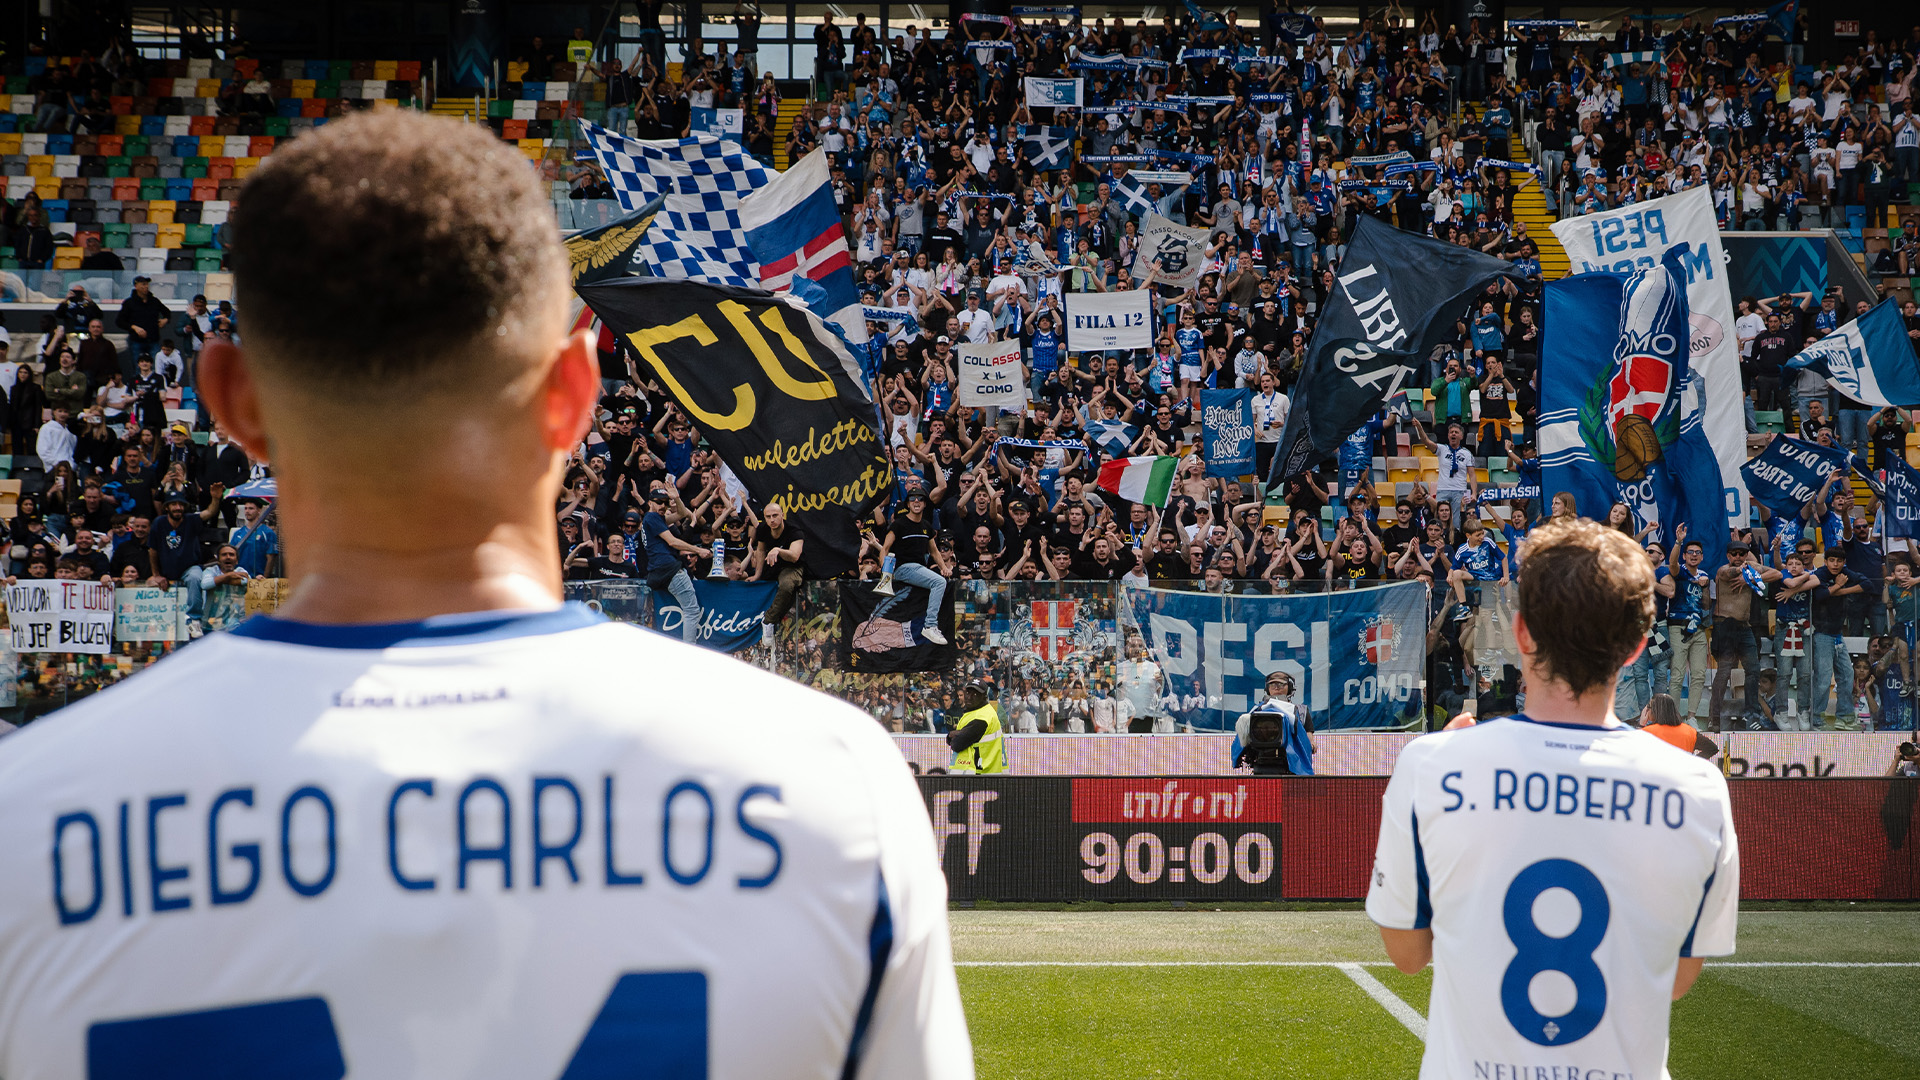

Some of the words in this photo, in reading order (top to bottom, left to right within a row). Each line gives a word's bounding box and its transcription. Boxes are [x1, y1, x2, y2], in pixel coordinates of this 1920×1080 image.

[1489, 158, 1509, 166] COMO
[1150, 227, 1172, 236] TASSO
[1075, 314, 1117, 329] FILA
[1124, 312, 1144, 327] 12
[963, 351, 1021, 367] COLLASSO
[982, 371, 990, 380] X
[995, 371, 1006, 380] IL
[976, 384, 1013, 394] COMO
[1052, 439, 1084, 448] COM
[1347, 434, 1367, 443] Uber
[1212, 439, 1241, 459] 1907
[61, 582, 77, 610] TE
[135, 590, 160, 600] NICO
[28, 622, 52, 649] JEP
[1150, 611, 1333, 713] PESI
[1343, 673, 1414, 706] COMO
[1123, 781, 1248, 819] infront
[1441, 770, 1476, 814] S.
[1493, 767, 1686, 830] ROBERTO
[51, 783, 338, 928] DIEGO
[385, 773, 789, 892] CARLOS
[1079, 832, 1274, 884] 90:00
[1500, 857, 1611, 1047] 8
